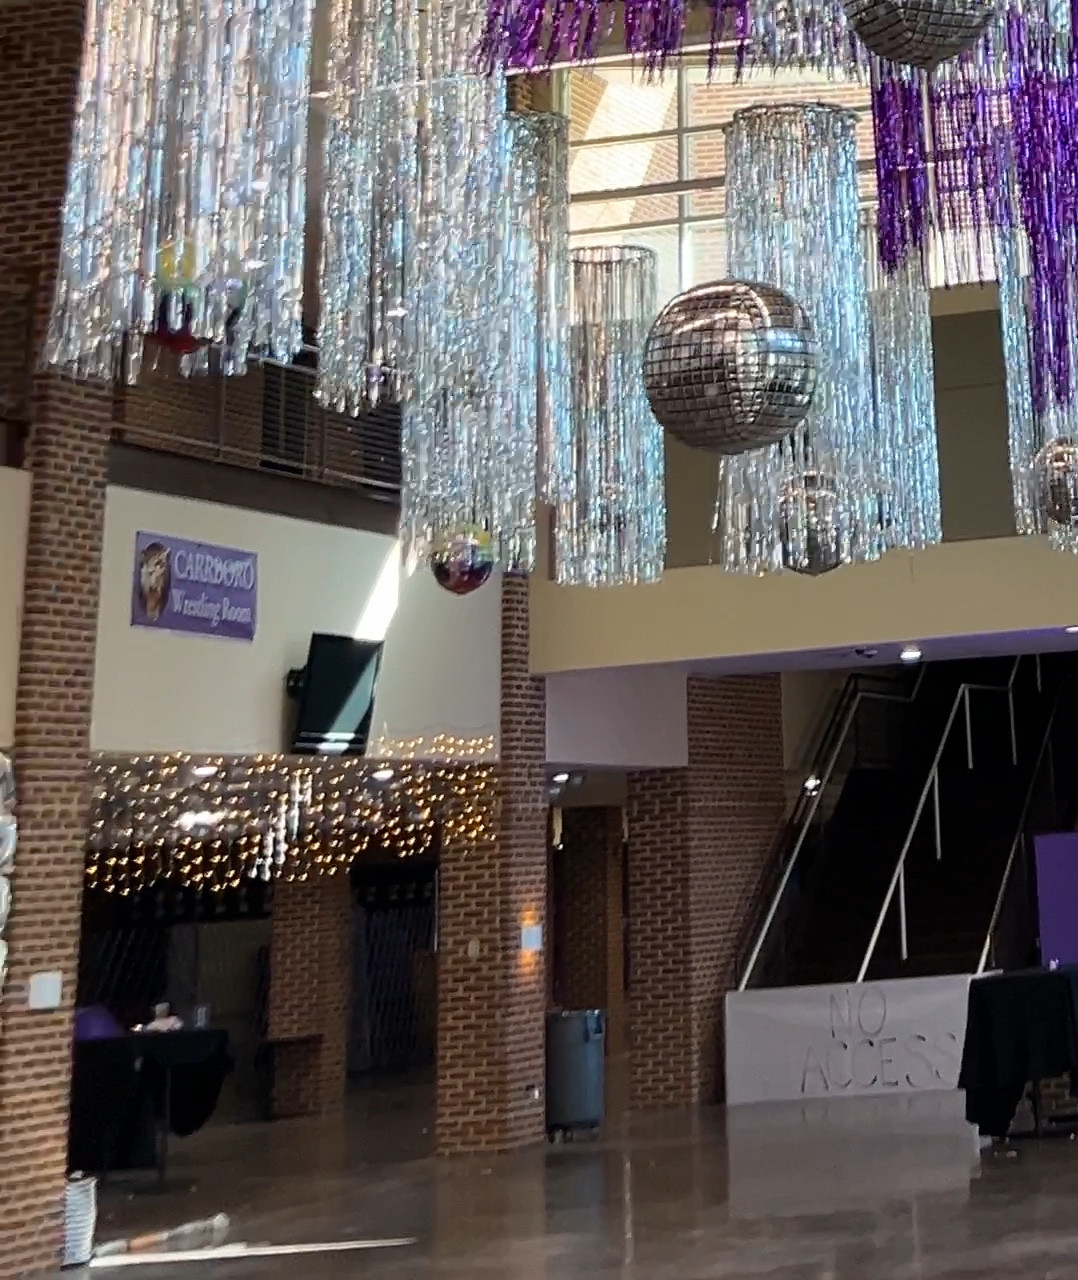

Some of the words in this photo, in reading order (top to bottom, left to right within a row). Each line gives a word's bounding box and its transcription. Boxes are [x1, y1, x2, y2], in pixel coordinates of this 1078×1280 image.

[174, 549, 255, 589] CARRBORO
[172, 587, 221, 627] Wrestling
[221, 597, 252, 623] Room
[829, 988, 887, 1039] NO
[800, 1032, 958, 1093] ACCESS
